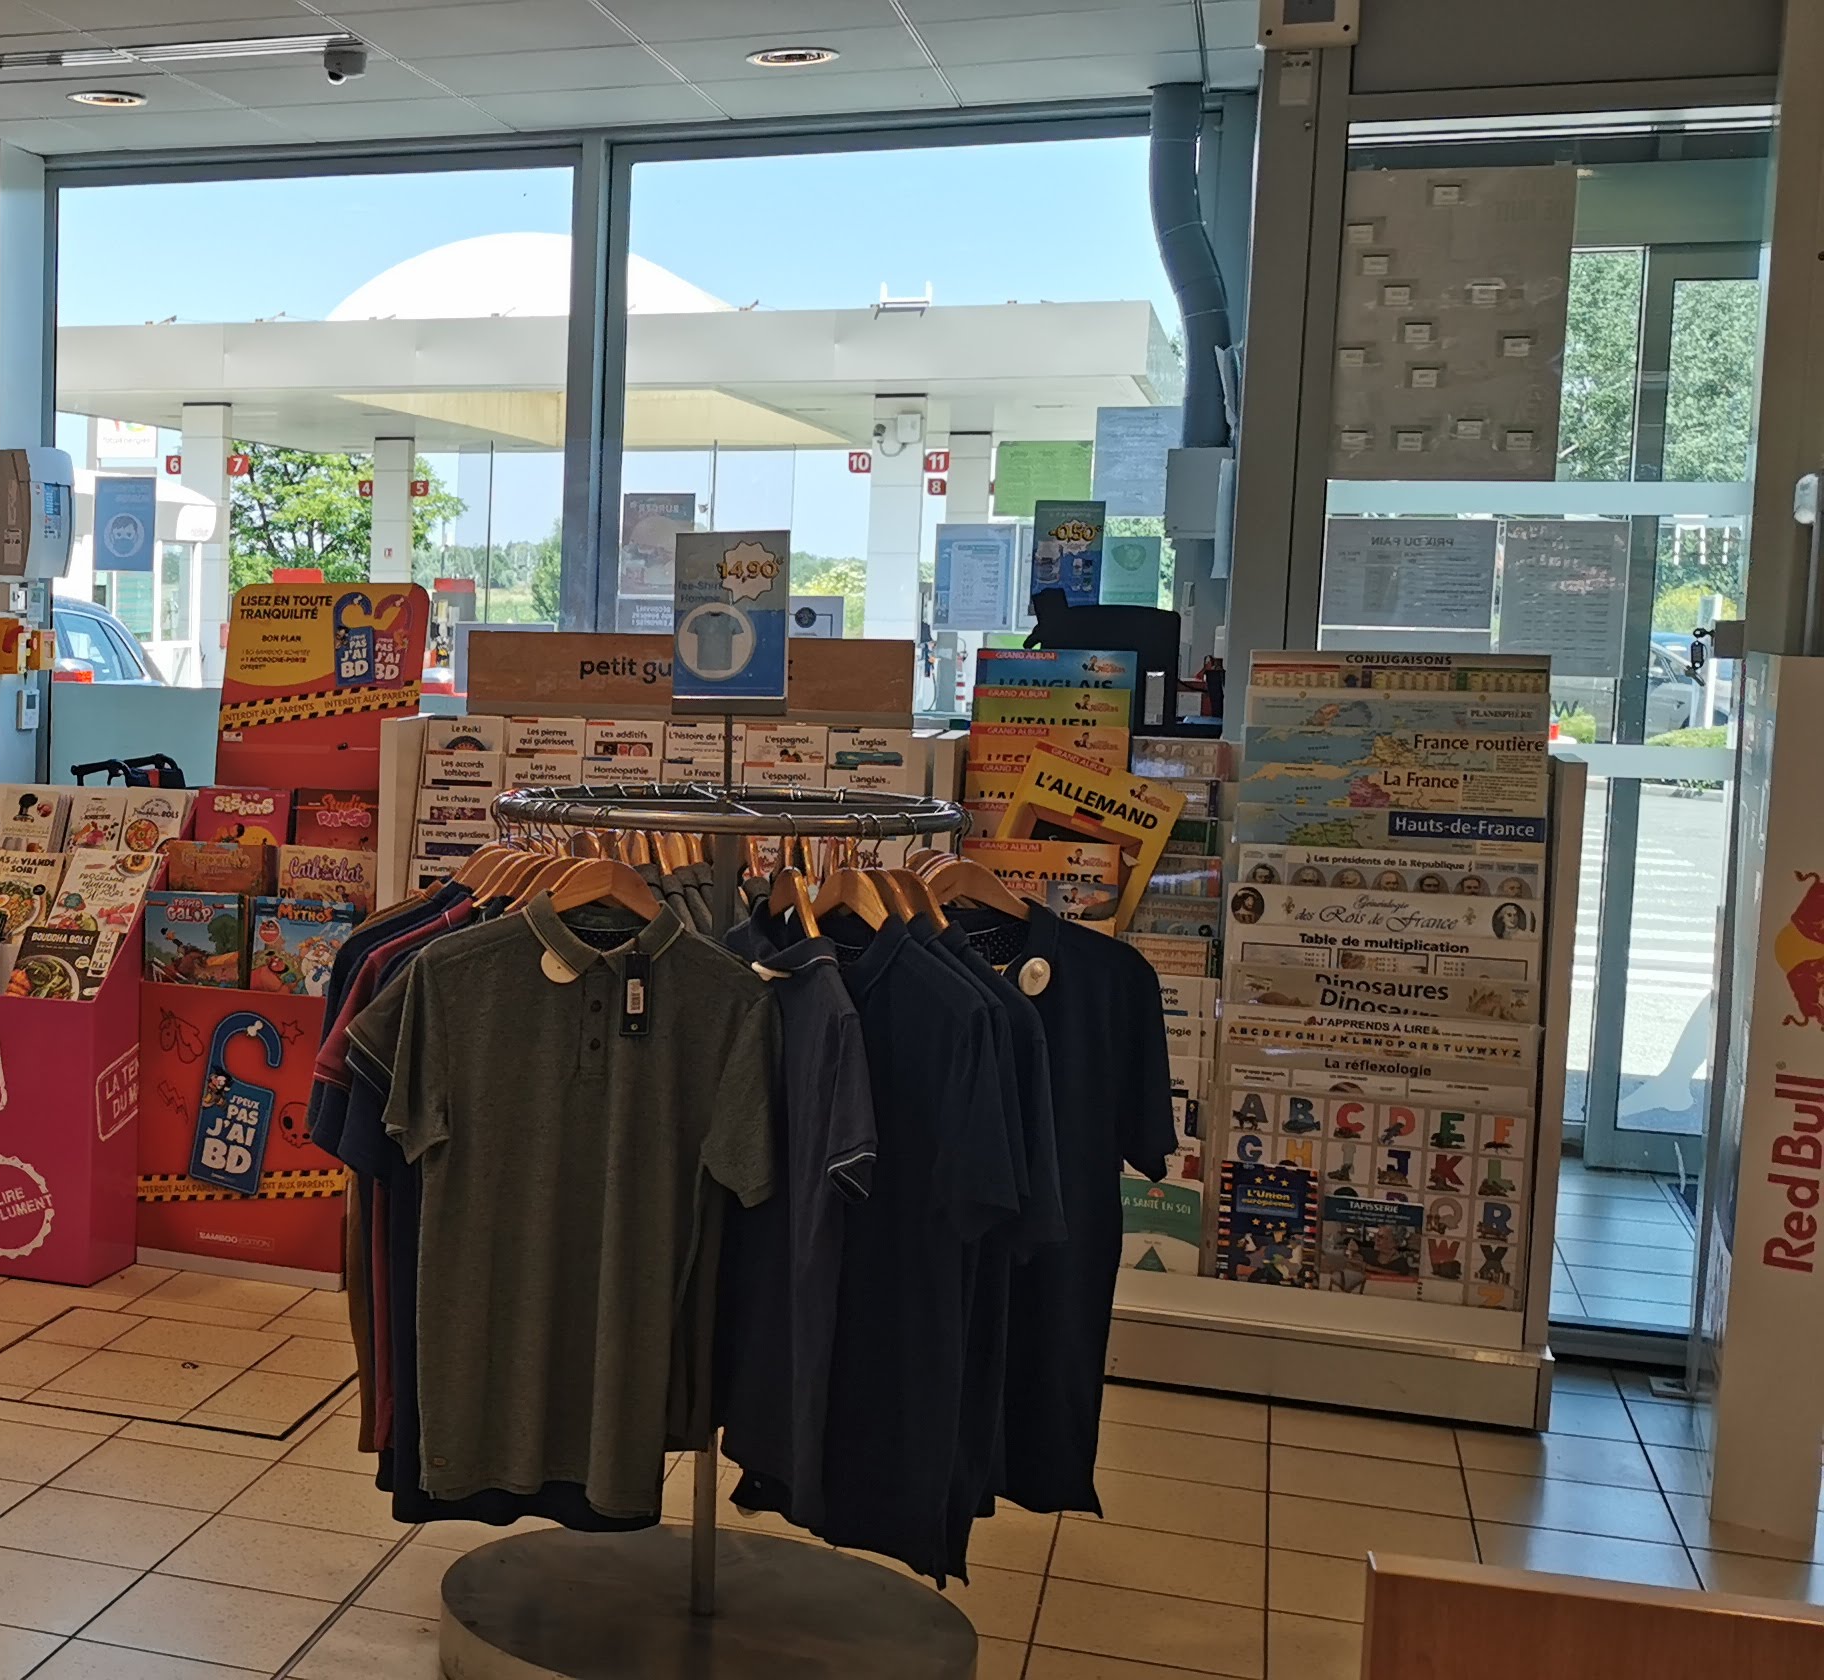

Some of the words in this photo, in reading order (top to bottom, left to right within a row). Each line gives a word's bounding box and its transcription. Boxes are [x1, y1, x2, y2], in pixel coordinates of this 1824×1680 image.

[170, 457, 179, 473] 6
[232, 457, 244, 474] 7
[849, 454, 870, 471] 10
[929, 454, 947, 470] 11
[361, 481, 371, 495] 4
[415, 481, 425, 495] 5
[932, 480, 942, 494] 8
[240, 595, 272, 607] LISEZ
[273, 595, 289, 607] EN
[292, 595, 333, 607] TOUTE
[240, 606, 319, 620] TRANQUILITÉ
[262, 634, 279, 643] BON
[281, 634, 302, 643] PLAN
[349, 639, 368, 651] PAS
[341, 649, 367, 661] J'AI
[1345, 654, 1453, 666] CONJUGAISONS
[340, 660, 369, 679] BD
[579, 655, 636, 685] petit
[324, 696, 362, 708] INTERDIT
[363, 694, 380, 703] AUX
[381, 689, 420, 702] PARENTS
[223, 709, 259, 722] INTERDIT
[260, 708, 276, 718] AUX
[278, 702, 315, 716] PARENTS
[1469, 707, 1534, 719] PLANISPHÈRE
[451, 725, 461, 733] Le
[462, 724, 482, 733] Reiki
[526, 727, 539, 737] Les
[540, 729, 567, 739] pierres
[600, 730, 614, 738] Les
[615, 729, 648, 739] additifs
[519, 737, 533, 746] qui
[534, 736, 575, 746] guérissent
[765, 735, 809, 747] L'espagnol
[851, 737, 887, 749] L'anglais
[1413, 733, 1470, 751] France
[1475, 734, 1545, 752] routière
[441, 760, 454, 768] Les
[455, 759, 485, 769] accords
[530, 762, 543, 771] Les
[543, 763, 557, 772] jus
[594, 766, 649, 776] Homéopathie
[515, 772, 529, 781] qui
[530, 771, 571, 782] guérissent
[683, 768, 696, 777] La
[697, 768, 721, 778] France
[762, 772, 807, 782] L'espagnol
[849, 774, 885, 785] L'anglais
[1382, 770, 1402, 787] La
[1406, 772, 1460, 790] France
[436, 794, 450, 802] Les
[451, 794, 481, 802] chakras
[1034, 771, 1159, 830] L'ALLEMAND
[1395, 816, 1537, 838] Hauts-de-France
[421, 829, 435, 838] Les
[436, 831, 457, 840] anges
[21, 857, 56, 868] VIANDE
[1313, 854, 1330, 865] Les
[1331, 855, 1382, 868] présidents
[1384, 857, 1397, 867] de
[1397, 858, 1408, 868] la
[1409, 859, 1465, 871] République
[289, 857, 321, 879] Cath
[333, 860, 364, 883] chat
[1295, 907, 1315, 921] des
[1318, 905, 1367, 926] Rois
[1367, 912, 1384, 926] de
[1385, 911, 1458, 933] France
[31, 933, 69, 944] BOUDDHA
[1299, 933, 1338, 947] Table
[1342, 935, 1360, 948] de
[1363, 936, 1470, 954] multiplication
[1316, 1016, 1390, 1032] J'APPRENDS
[1393, 1019, 1402, 1033] À
[1404, 1022, 1432, 1036] LIRE
[1324, 1058, 1340, 1069] La
[1345, 1058, 1432, 1077] réflexologie
[105, 1073, 121, 1099] LA
[112, 1095, 128, 1119] DU
[227, 1106, 259, 1126] PAS
[1771, 1073, 1824, 1170] Bull
[206, 1117, 257, 1147] J'AI
[200, 1137, 253, 1174] BD
[278, 1181, 296, 1190] AUX
[296, 1180, 336, 1189] PARENTS
[1247, 1189, 1291, 1201] L'Union
[1132, 1195, 1160, 1210] SANTÉ
[1161, 1199, 1174, 1211] EN
[1175, 1201, 1192, 1214] SOI
[1349, 1200, 1399, 1213] TAPISSERIE
[1762, 1172, 1820, 1273] Red
